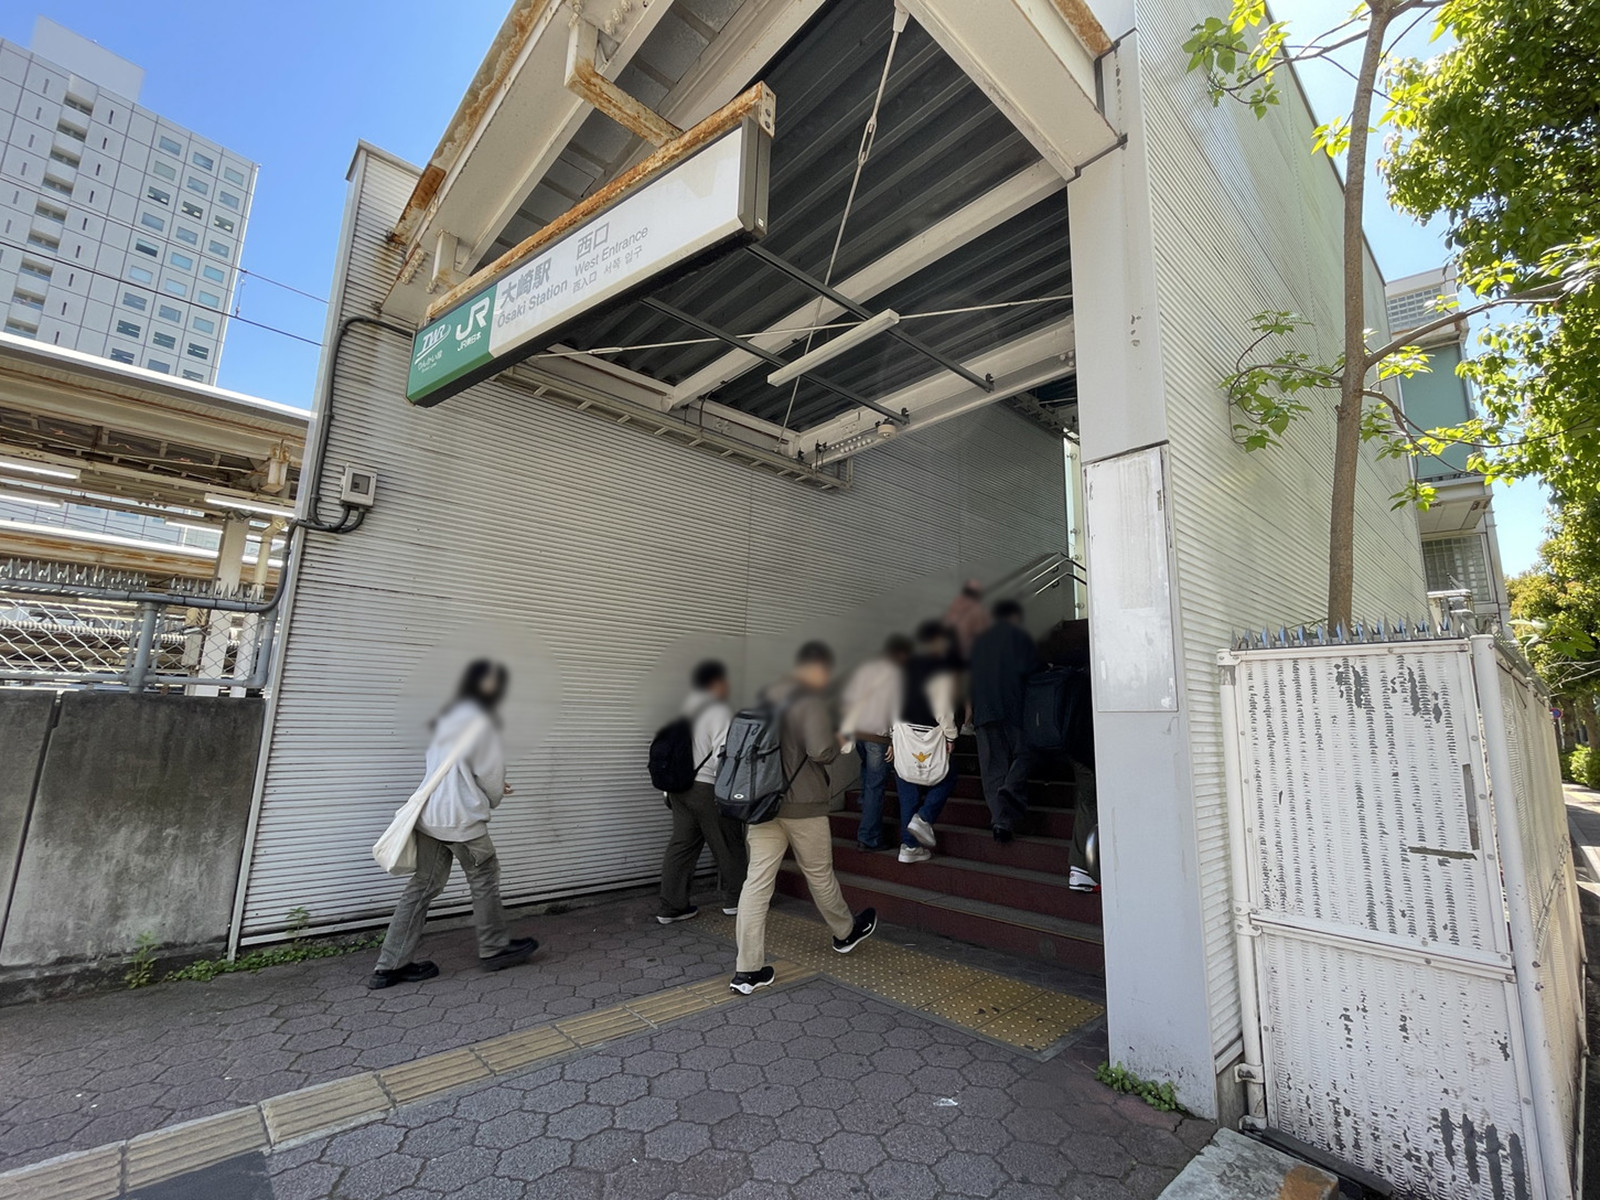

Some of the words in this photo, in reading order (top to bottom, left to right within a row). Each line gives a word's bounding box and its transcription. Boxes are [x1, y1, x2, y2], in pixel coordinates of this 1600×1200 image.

[575, 254, 599, 276] West
[602, 226, 649, 262] Entrance
[576, 222, 610, 260] 西口
[624, 246, 643, 265] 입구
[500, 257, 552, 309] 大崎駅
[528, 279, 568, 310] Station
[572, 271, 597, 293] 西入口
[455, 297, 490, 341] JR
